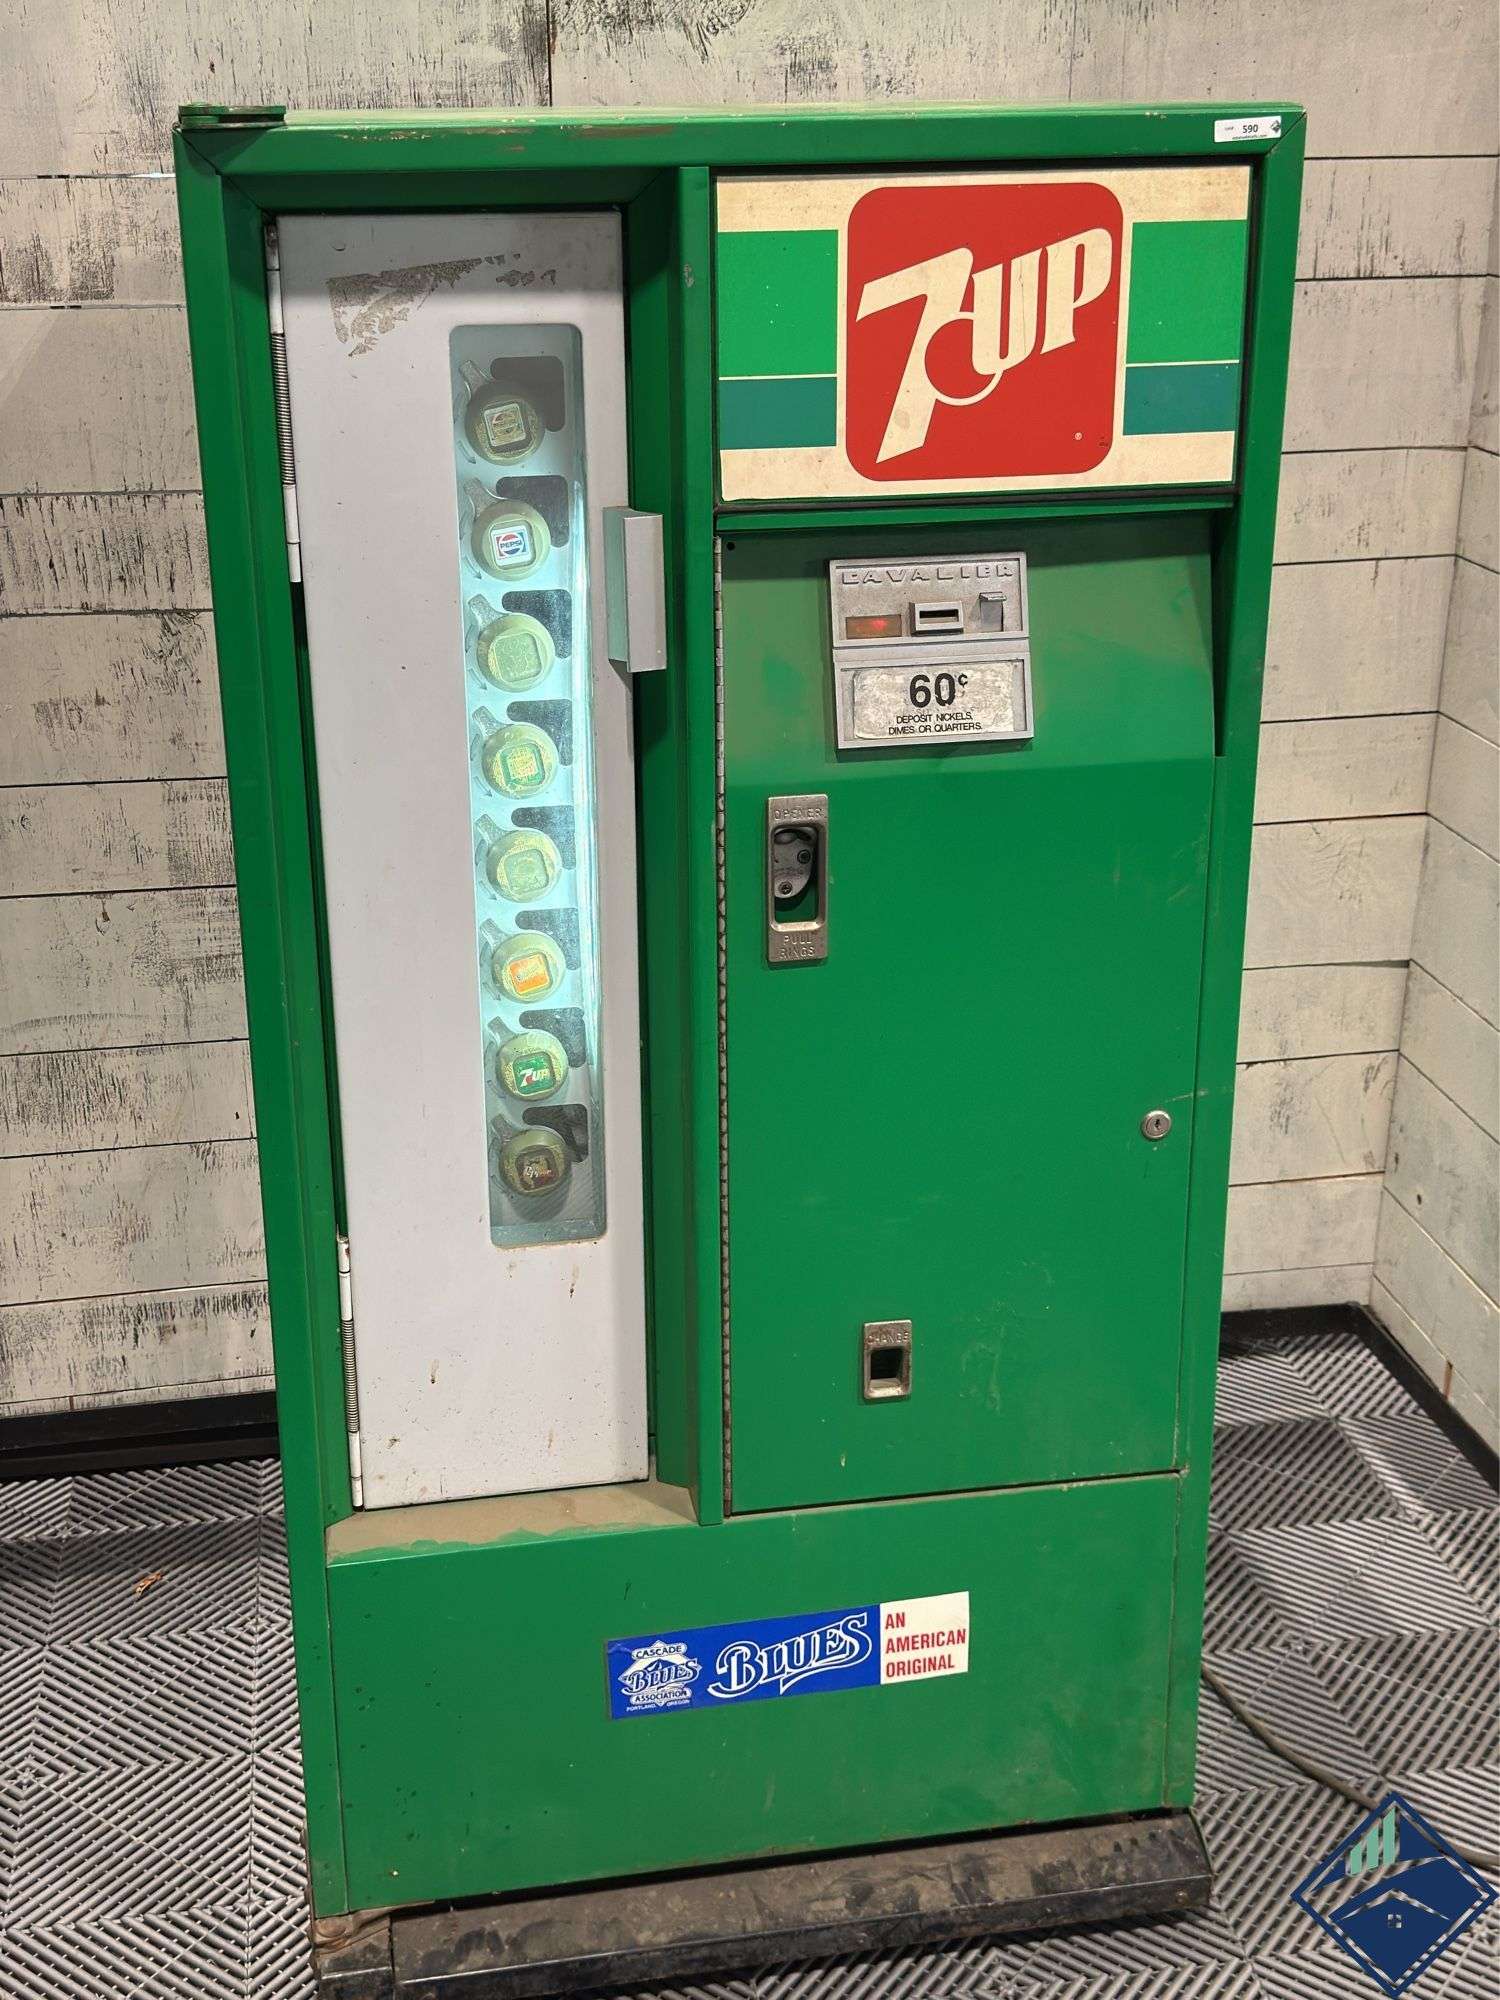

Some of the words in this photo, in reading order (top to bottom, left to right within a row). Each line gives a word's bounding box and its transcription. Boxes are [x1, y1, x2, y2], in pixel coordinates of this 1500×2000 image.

[1242, 124, 1259, 134] 590
[855, 228, 1113, 464] 7UP
[500, 540, 523, 549] PEPSI
[841, 563, 1014, 585] CAVALIER
[896, 714, 932, 724] DEPOSIT
[888, 725, 915, 735] DIMES
[918, 724, 932, 733] OR
[774, 807, 823, 821] OPENER
[783, 933, 814, 945] PULL
[779, 946, 816, 960] RINGS
[885, 1611, 906, 1631] AN
[884, 1628, 967, 1655] AMERICAN
[635, 1645, 682, 1659] CASCADE
[706, 1612, 872, 1699] BLUES
[885, 1653, 956, 1679] ORIGINAL
[622, 1658, 700, 1695] BLUES
[634, 1689, 688, 1702] ASSOCIATION
[666, 1699, 691, 1707] OREGON
